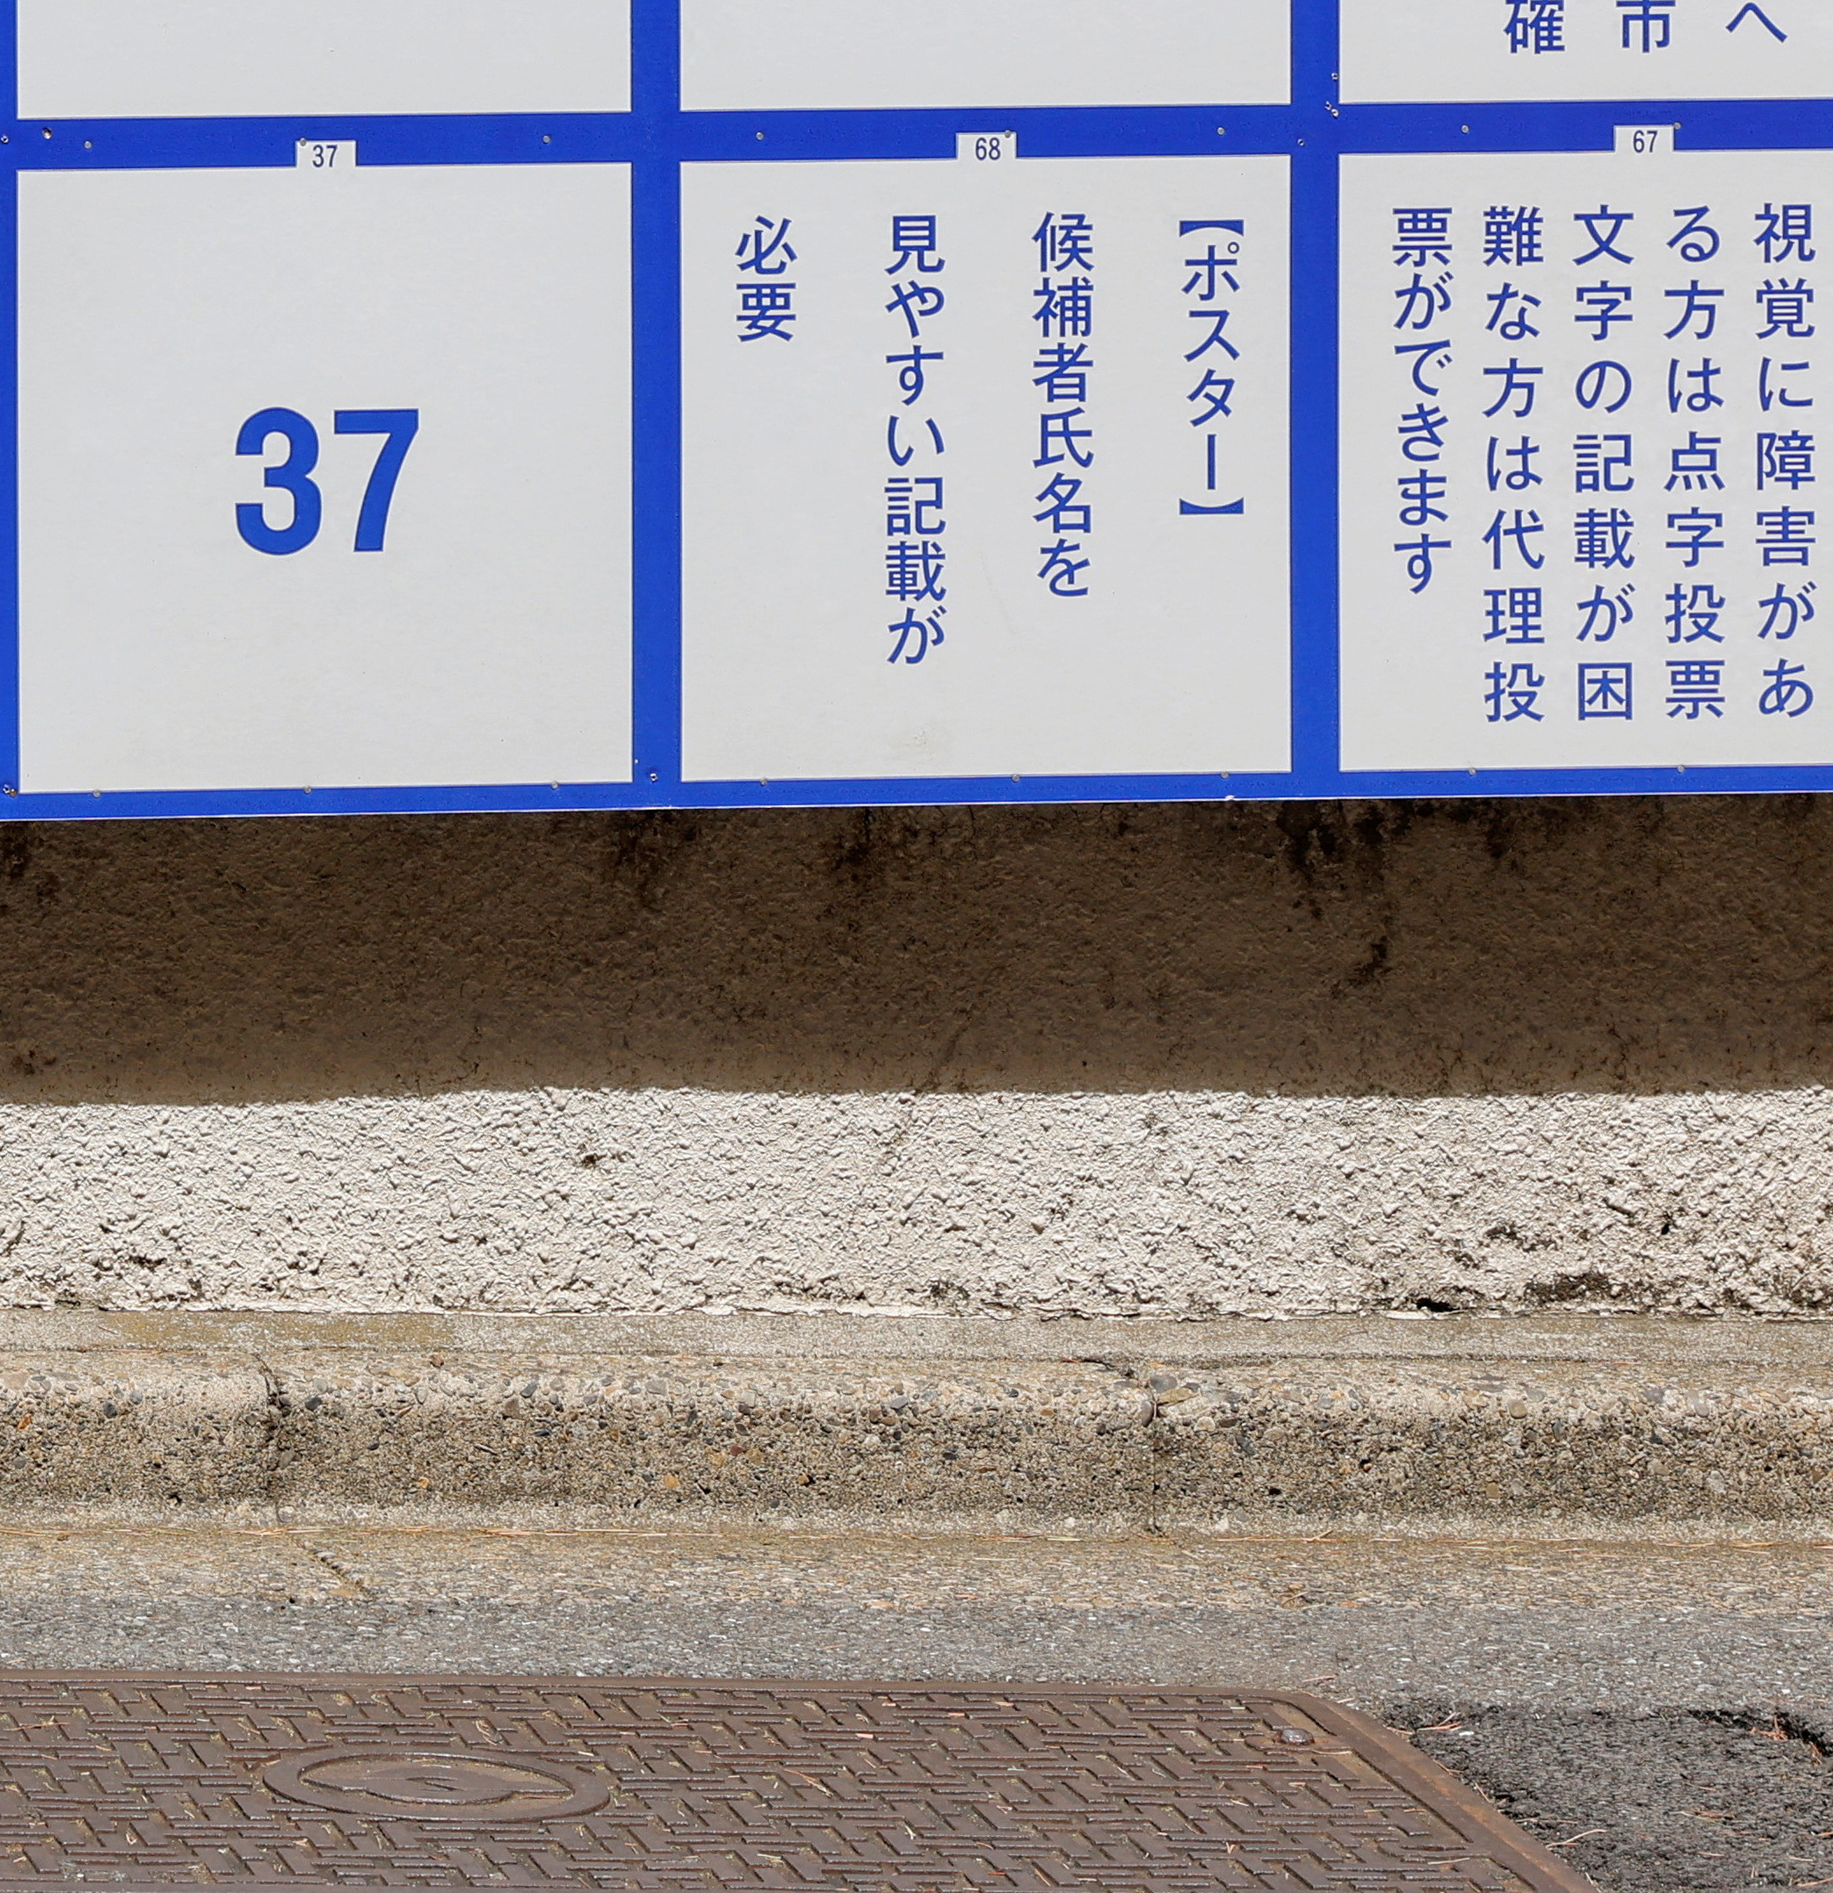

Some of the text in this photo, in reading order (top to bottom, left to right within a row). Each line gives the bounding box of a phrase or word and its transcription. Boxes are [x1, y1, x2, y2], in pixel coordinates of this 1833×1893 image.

[312, 144, 339, 168] 37
[735, 214, 798, 343] 必要
[974, 137, 1001, 161] 68
[1632, 129, 1659, 153] 67
[234, 407, 419, 555] 37
[883, 213, 947, 665] 見やすい記載が
[1031, 211, 1095, 598] 候補者氏名を
[1178, 218, 1245, 516] 【ポスター】
[1392, 206, 1454, 595] 票ができます
[1481, 205, 1546, 723] 難な方は代理投
[1572, 204, 1636, 721] 文字の記載が困
[1662, 205, 1726, 720] る方は点字投票
[1753, 202, 1817, 720] 視覚に障害があ
